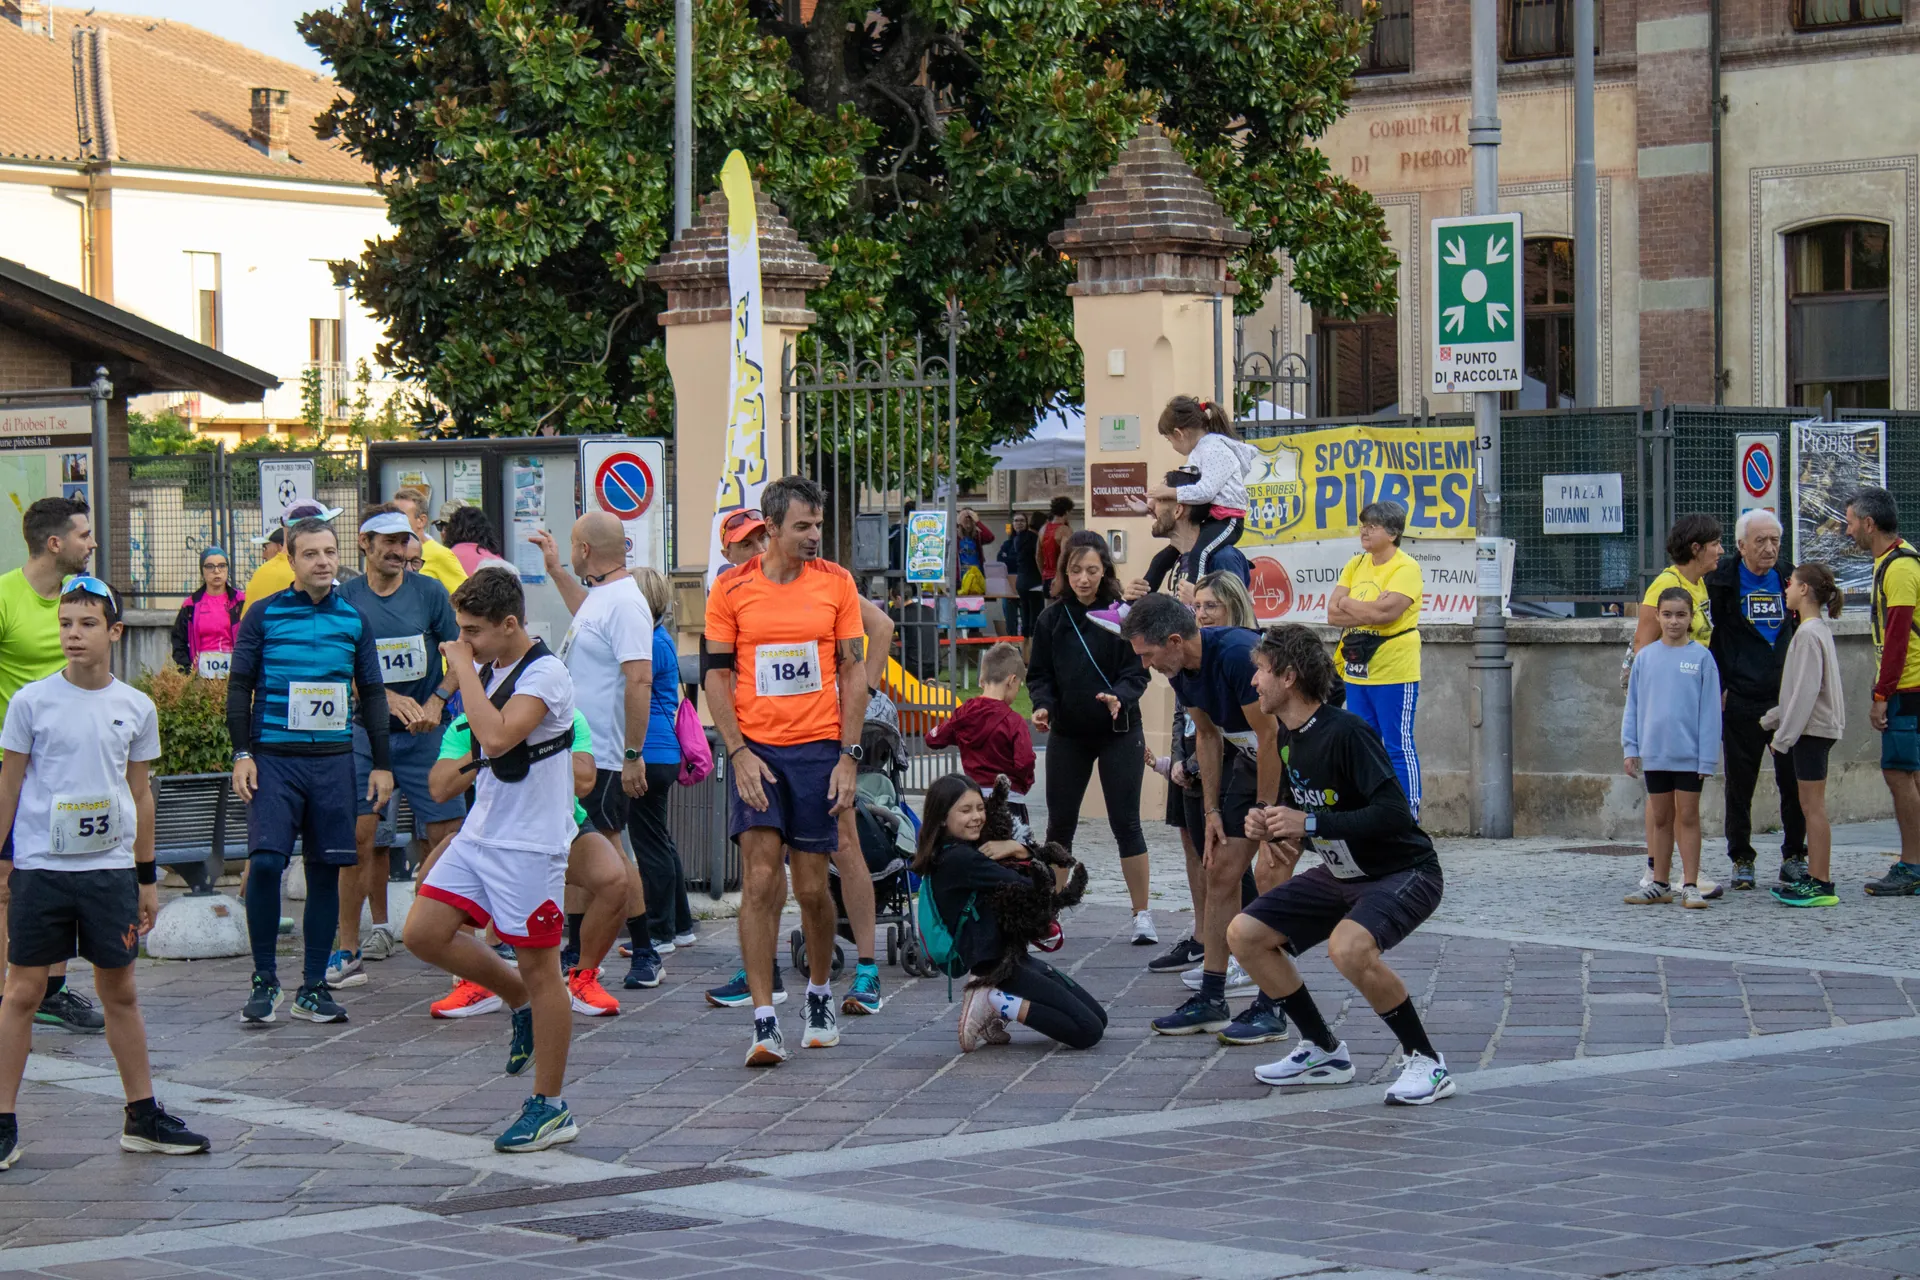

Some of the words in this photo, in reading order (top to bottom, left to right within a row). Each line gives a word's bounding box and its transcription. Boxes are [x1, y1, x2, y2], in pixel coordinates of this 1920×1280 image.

[1351, 155, 1370, 173] DI
[1400, 147, 1473, 171] PIEMON
[1455, 352, 1497, 365] PUNTO
[1435, 372, 1447, 383] DI
[1453, 368, 1518, 383] RACCOLTA
[3, 418, 12, 432] di
[14, 416, 47, 432] Piobesi
[49, 415, 68, 430] T.se
[1093, 486, 1111, 496] SCUOLA
[1112, 486, 1145, 495] DELL'INFANZIA
[1246, 486, 1256, 498] SD
[1258, 486, 1265, 497] S.
[1266, 484, 1297, 496] PIOBESI
[1561, 485, 1604, 499] PIAZZA
[1248, 506, 1260, 521] 20
[1276, 503, 1290, 519] 07
[1545, 507, 1590, 524] GIOVANNI
[1297, 593, 1326, 612] MA
[1420, 593, 1476, 612] ENIN
[1753, 603, 1777, 613] 534
[206, 660, 229, 671] 104
[382, 653, 413, 670] 141
[1349, 662, 1365, 674] 347
[1680, 661, 1700, 671] LOVE
[772, 661, 811, 681] 184
[310, 700, 335, 717] 70
[78, 814, 110, 837] 53
